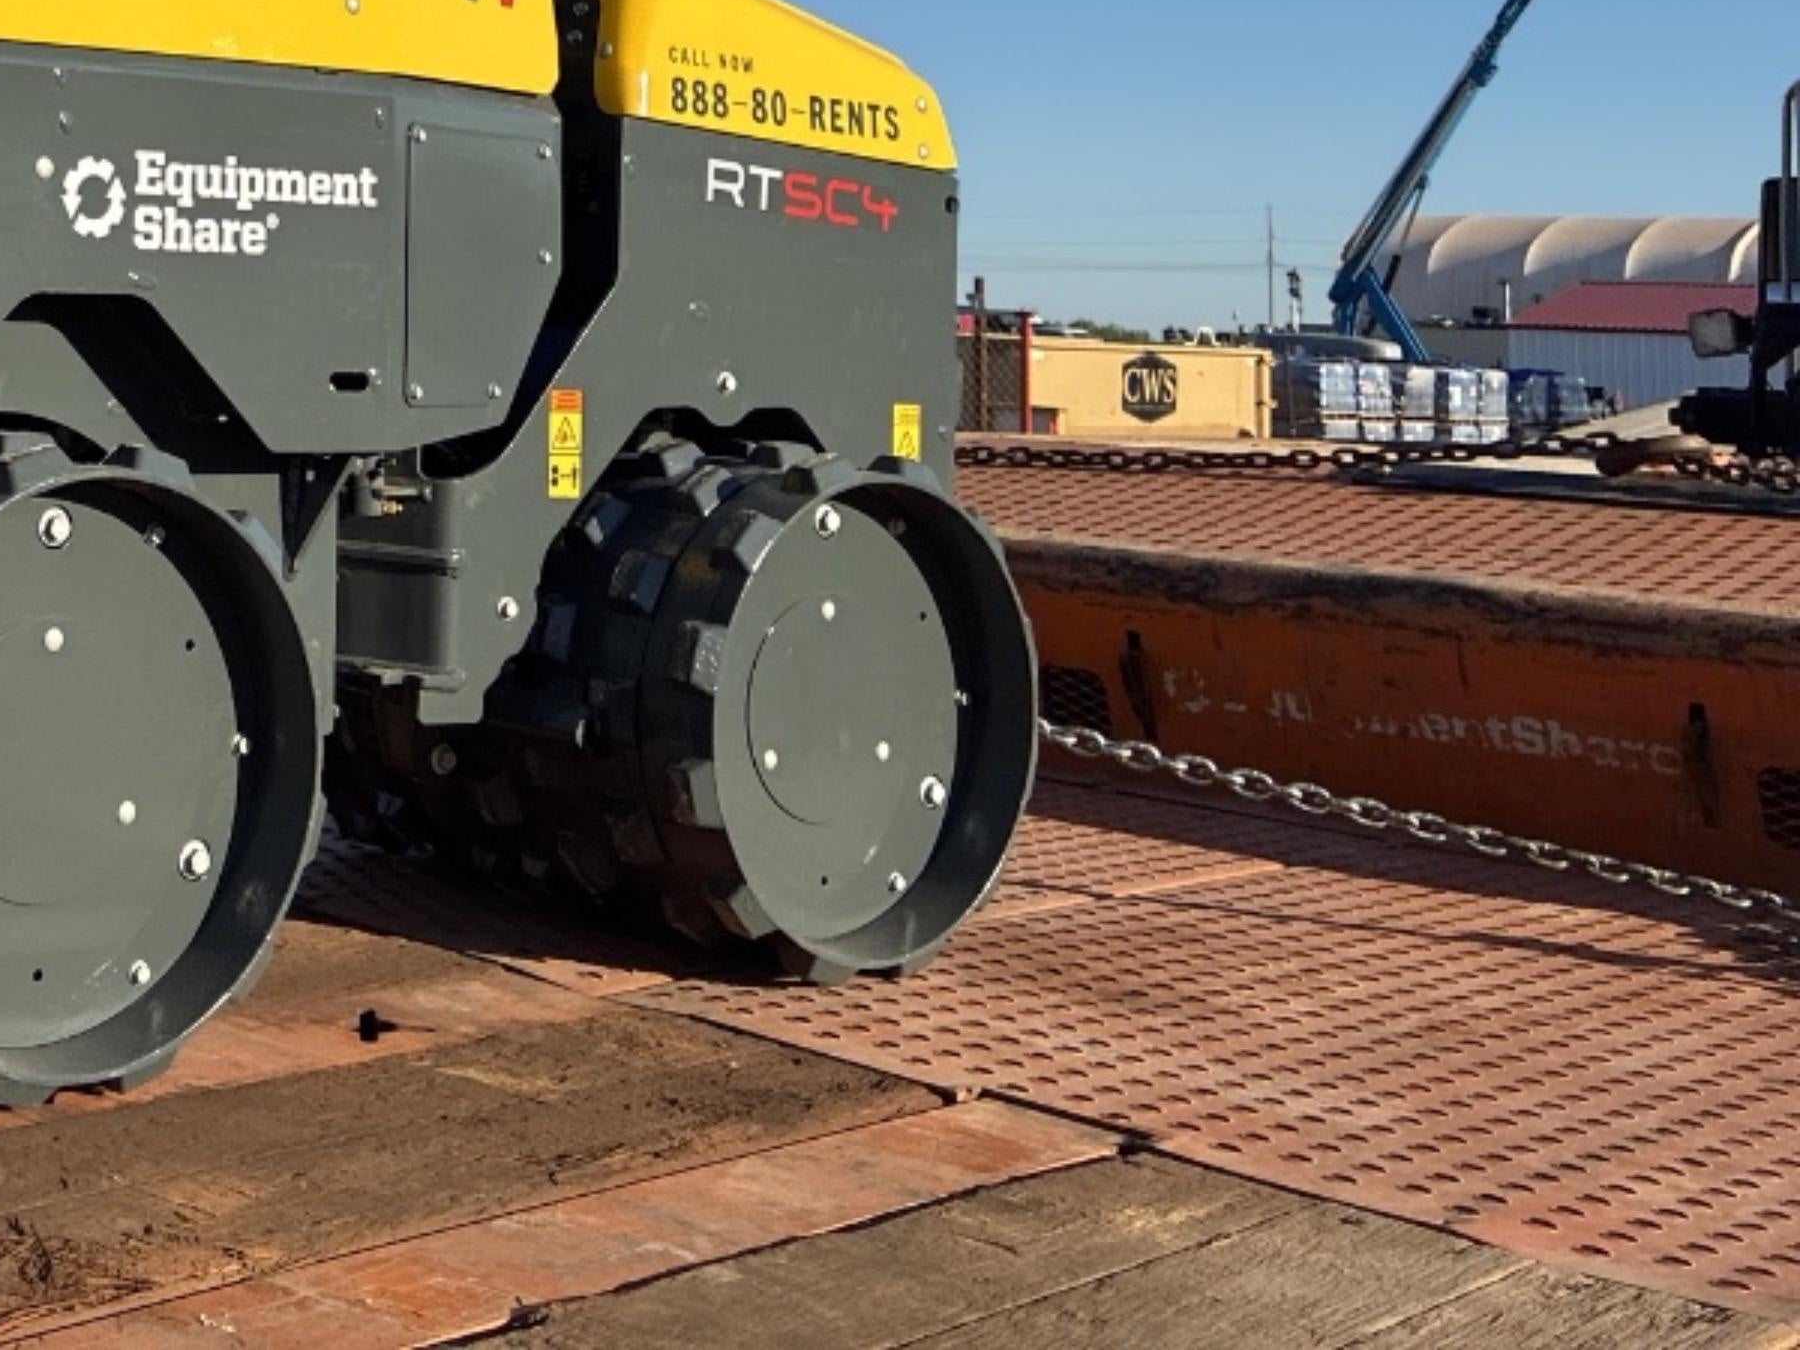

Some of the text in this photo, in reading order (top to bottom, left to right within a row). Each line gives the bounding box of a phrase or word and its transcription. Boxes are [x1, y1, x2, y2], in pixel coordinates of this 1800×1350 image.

[668, 45, 754, 74] CALL NOW
[670, 75, 901, 142] 888-80-RENTS
[134, 150, 380, 211] Equipment
[706, 158, 898, 233] RTSC4
[1125, 368, 1175, 404] CWS
